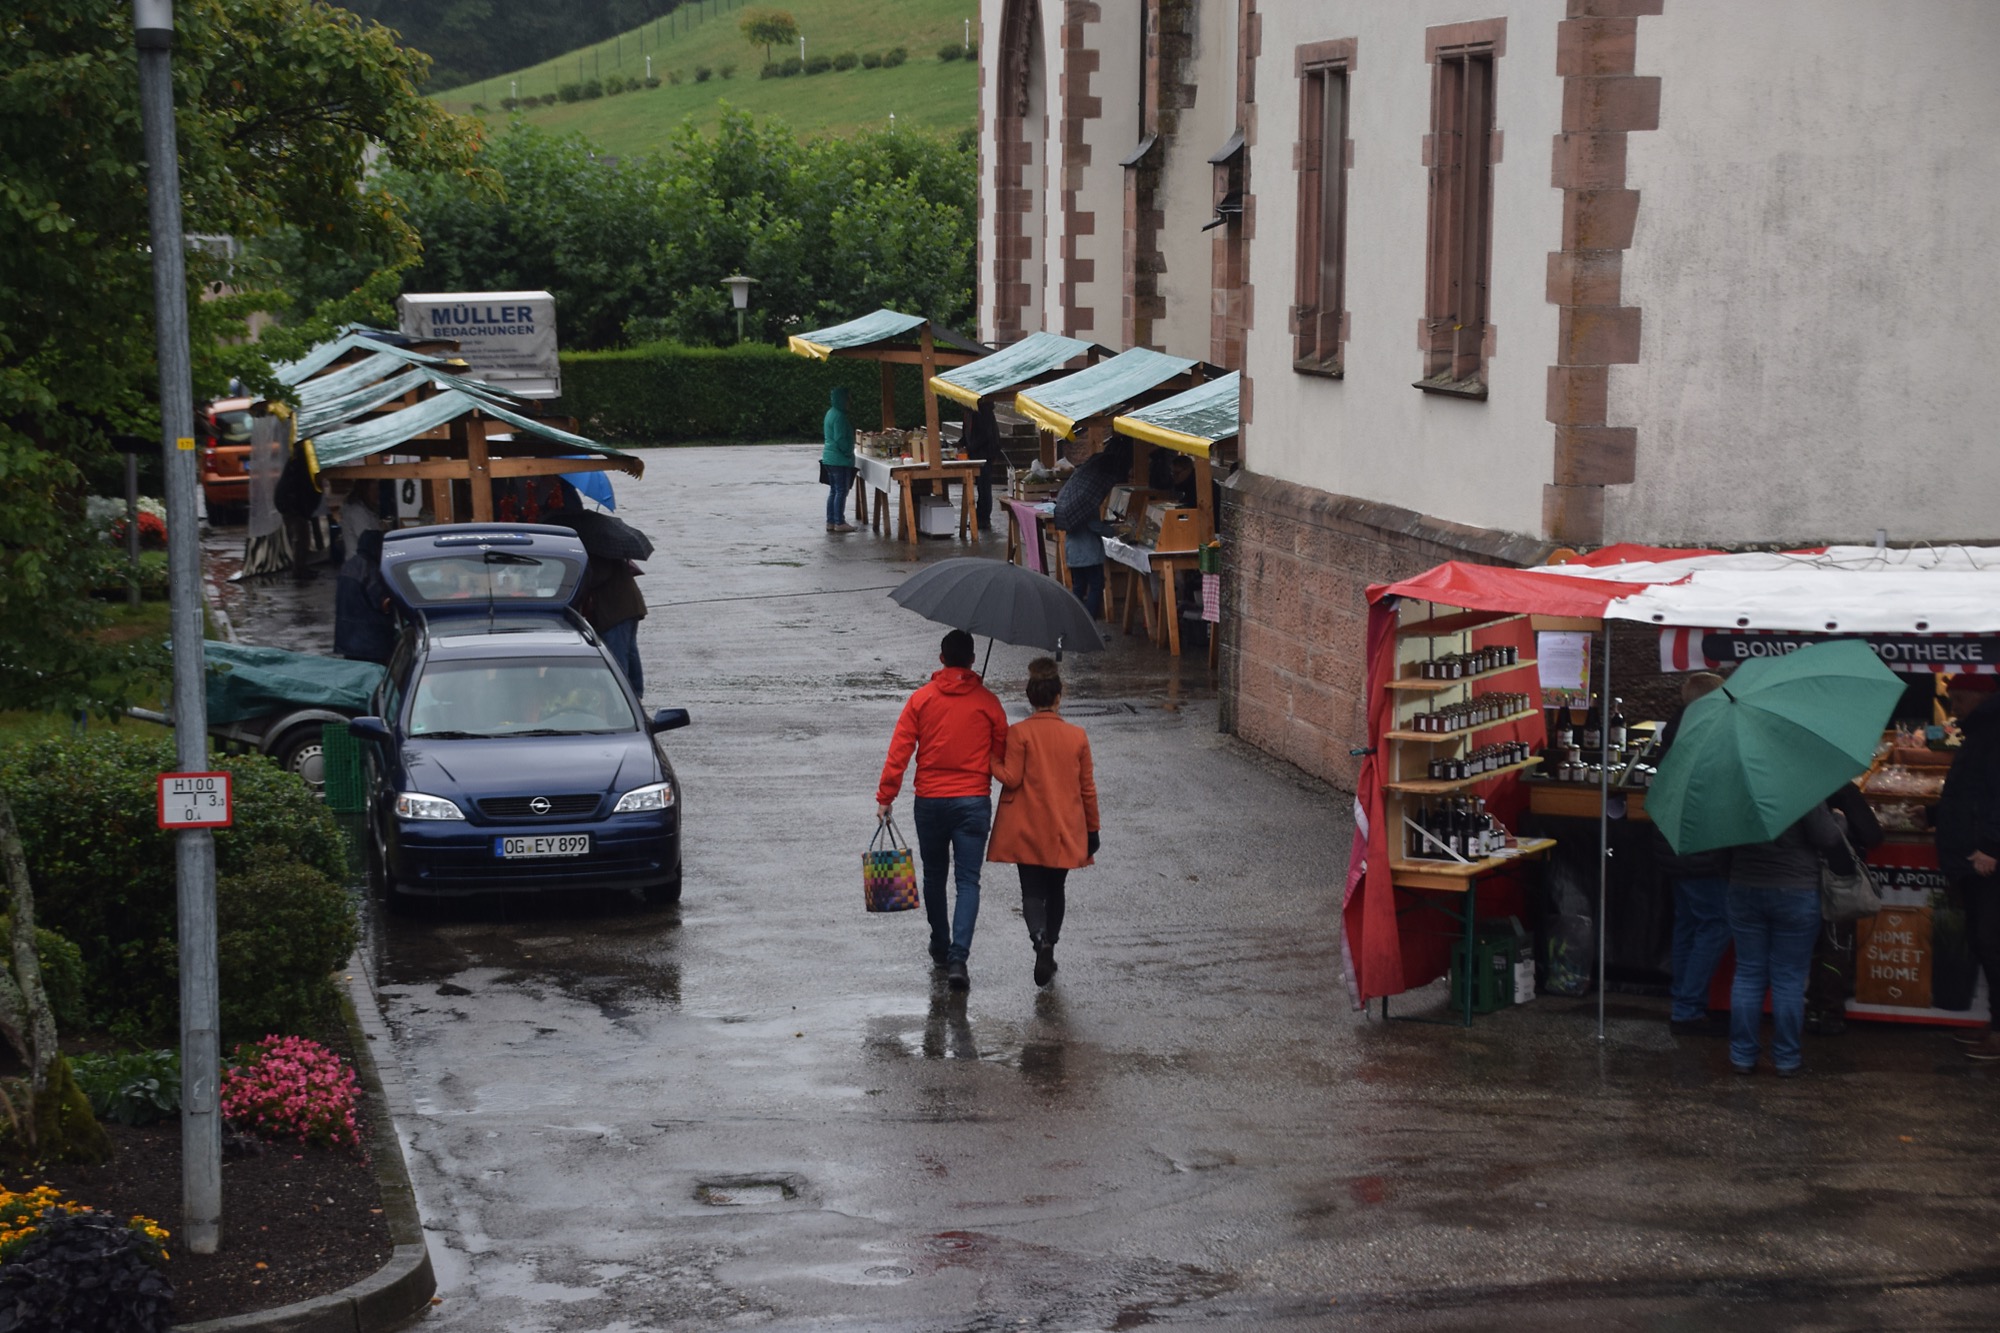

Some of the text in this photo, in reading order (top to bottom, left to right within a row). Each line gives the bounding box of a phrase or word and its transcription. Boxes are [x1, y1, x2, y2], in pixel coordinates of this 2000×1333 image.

[431, 304, 534, 325] MÜLLER
[433, 325, 535, 337] BEDACHUNGEN
[175, 778, 214, 791] H100
[504, 836, 588, 854] OG EY 899
[1873, 931, 1915, 945] HOME
[1866, 946, 1925, 964] SWEET
[1871, 966, 1919, 982] HOME
